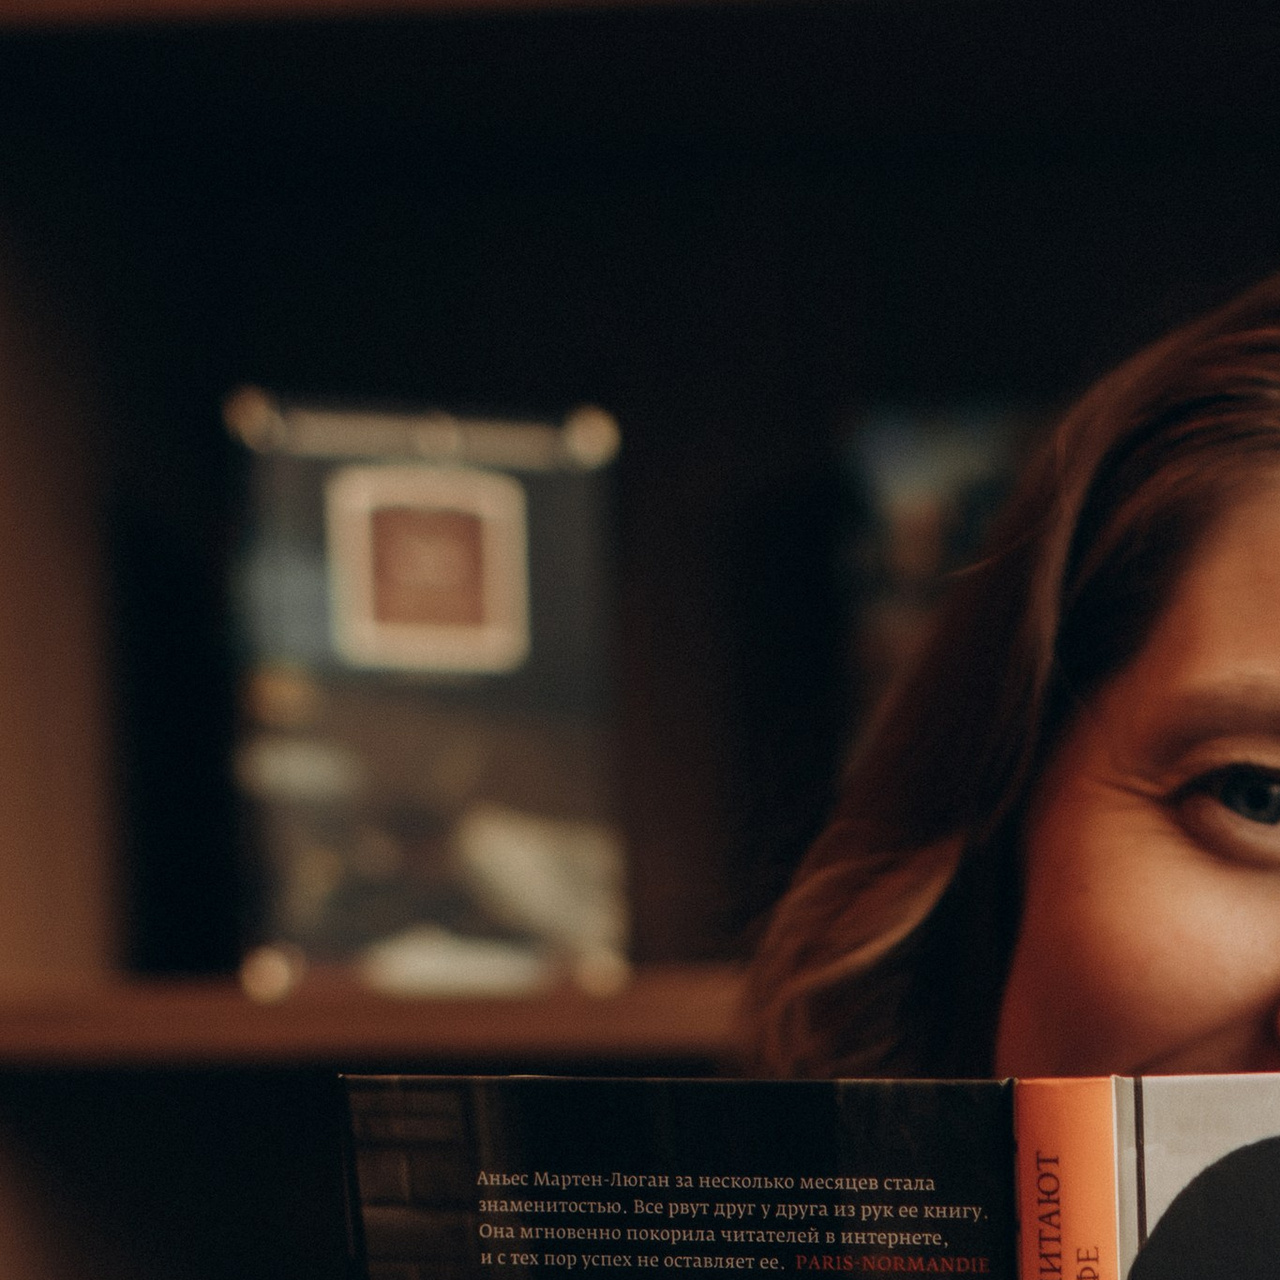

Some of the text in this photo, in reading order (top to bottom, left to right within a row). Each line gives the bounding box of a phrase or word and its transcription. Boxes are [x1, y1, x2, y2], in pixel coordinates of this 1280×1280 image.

[476, 1168, 936, 1194] Аньес Мартен-Люган за несколько месяцев стала
[478, 1198, 989, 1224] знаменитостью. Все рвут друг у друга из рук ее книгу.
[478, 1221, 949, 1249] Она мгновенно покорила читателей в интернете,
[480, 1251, 990, 1274] и с тех пор успех не оставляет ее. PARIS-NORMANDIE
